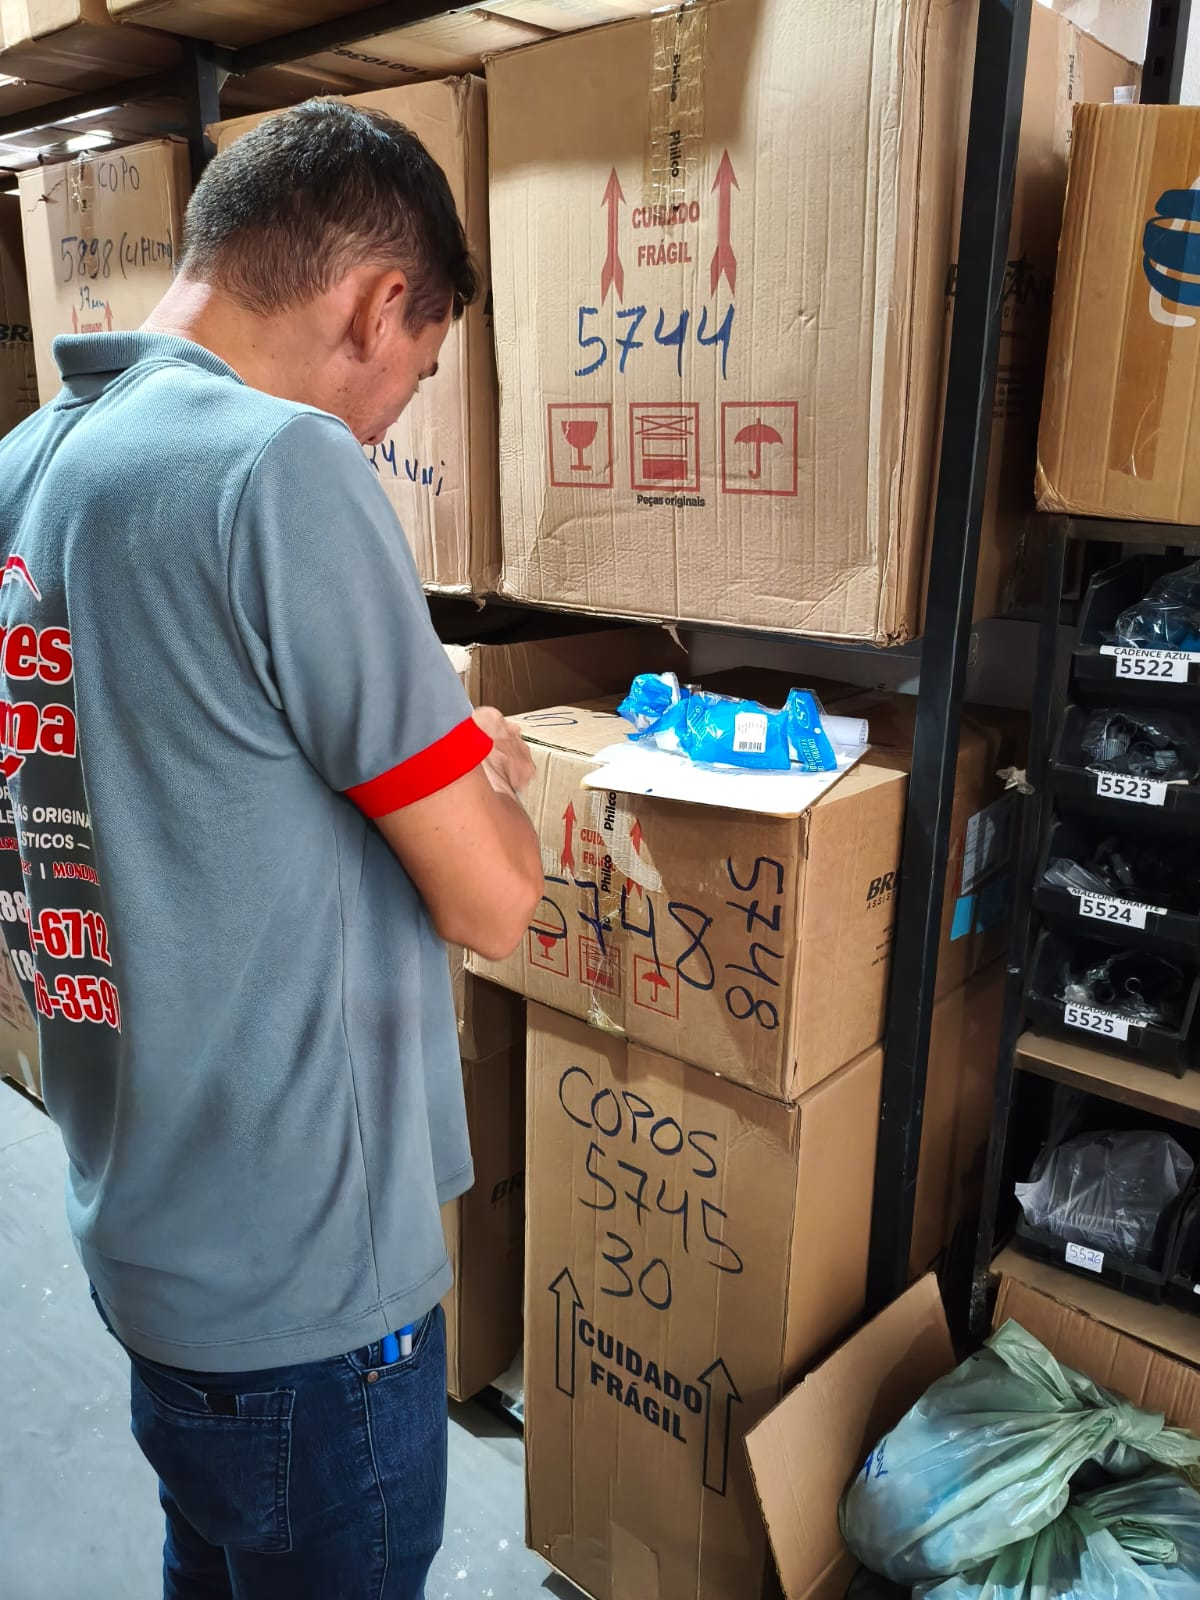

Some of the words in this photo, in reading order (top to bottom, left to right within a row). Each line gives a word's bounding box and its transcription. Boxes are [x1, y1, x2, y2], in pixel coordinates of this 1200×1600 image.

[98, 156, 140, 192] COPO
[61, 236, 113, 282] 5898
[637, 240, 692, 268] FRÁGIL
[574, 303, 735, 381] 5744
[637, 494, 663, 508] Peças
[665, 495, 706, 509] originais
[1113, 646, 1162, 660] CADENCE
[1164, 651, 1192, 661] AZUL
[1120, 658, 1174, 678] 5522
[1100, 776, 1152, 800] 5523
[603, 791, 618, 832] Philco
[600, 854, 613, 894] Philco
[866, 871, 897, 901] BR
[1072, 887, 1116, 903] MALLORY
[1083, 899, 1132, 923] 5524
[724, 855, 785, 1030] 5748
[1068, 1008, 1115, 1034] 5525
[558, 1066, 718, 1179] COPOS
[578, 1141, 744, 1274] 5745
[600, 1231, 672, 1311] 30
[1070, 1244, 1102, 1264] 5526
[578, 1318, 703, 1415] CUIDADO
[590, 1360, 688, 1445] FRÁGIL
